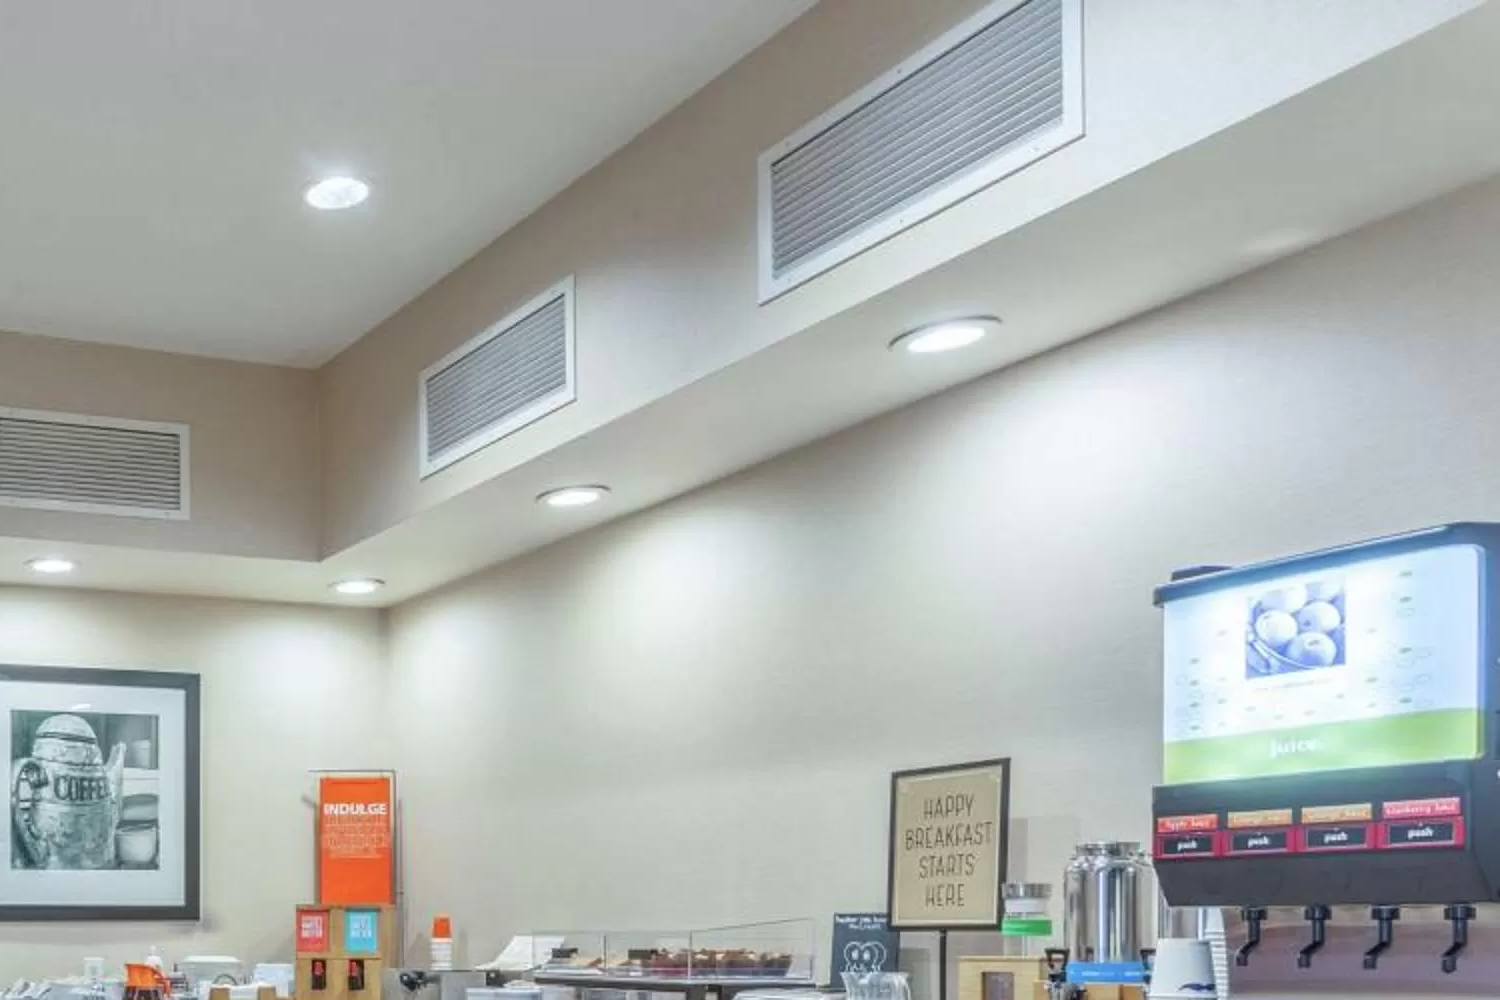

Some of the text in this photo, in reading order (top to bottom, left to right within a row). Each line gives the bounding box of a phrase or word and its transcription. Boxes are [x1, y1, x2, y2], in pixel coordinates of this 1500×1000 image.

[323, 803, 388, 816] INDULGE
[924, 794, 974, 819] HAPPY
[905, 821, 993, 850] BREAKFAST
[1323, 831, 1349, 844] push
[1407, 828, 1435, 840] push
[919, 853, 976, 880] STARTS
[925, 883, 965, 907] HERE
